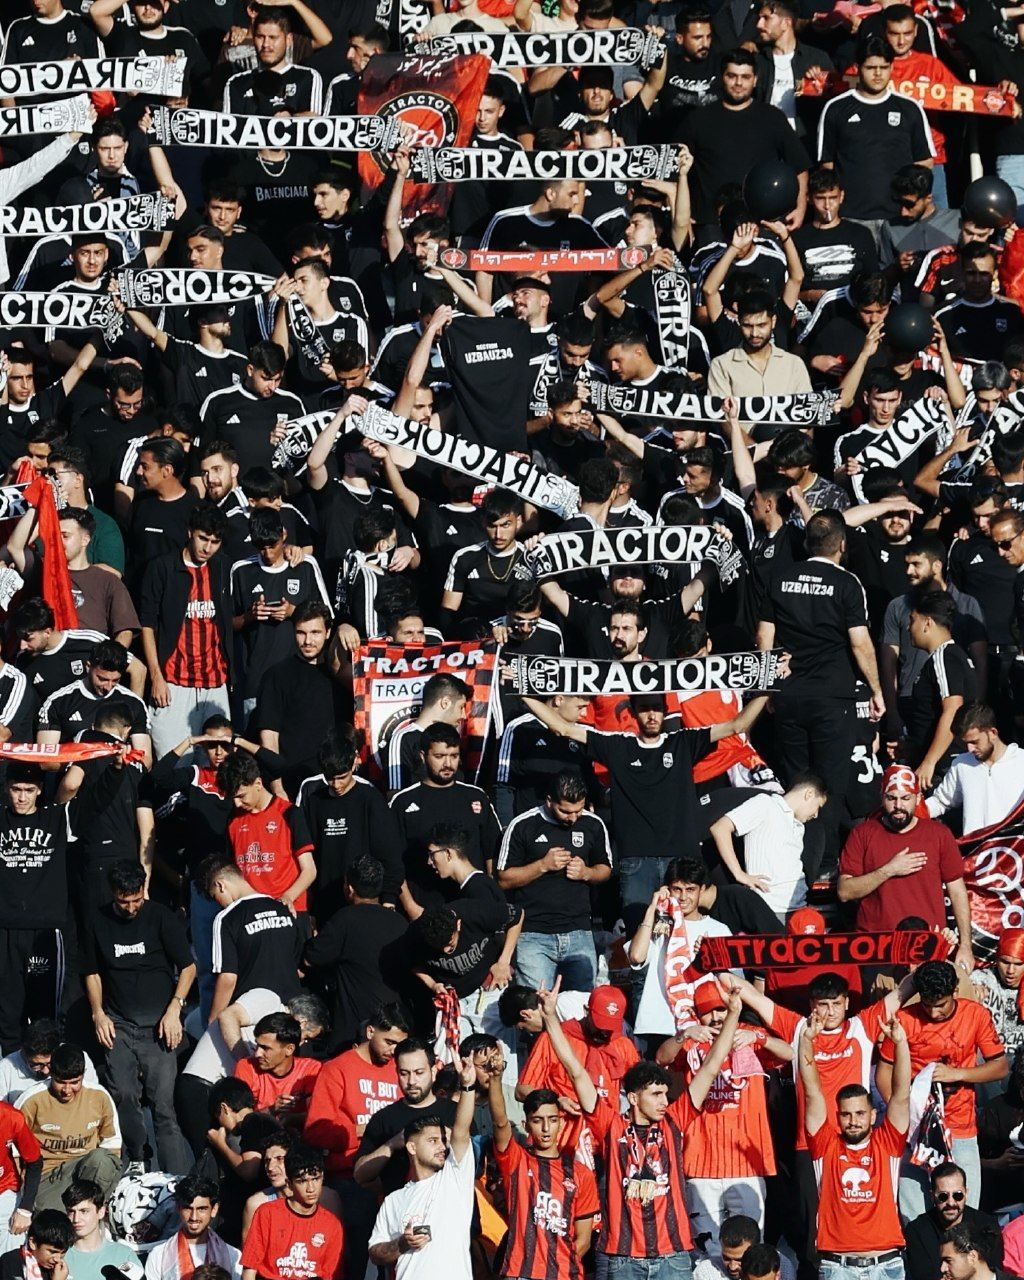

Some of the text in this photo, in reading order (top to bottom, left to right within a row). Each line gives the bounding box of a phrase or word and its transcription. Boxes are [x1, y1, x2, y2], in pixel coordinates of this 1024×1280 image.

[456, 31, 617, 66] TRACTOR
[200, 117, 355, 149] TRACTOR
[465, 149, 628, 179] TRACTOR
[464, 348, 514, 364] UZBAUZ34
[640, 391, 790, 421] TRACOR
[545, 528, 707, 569] TRACTOR
[362, 649, 485, 674] TRACTOR
[559, 657, 730, 693] TRACTOR
[376, 681, 424, 698] TRAC
